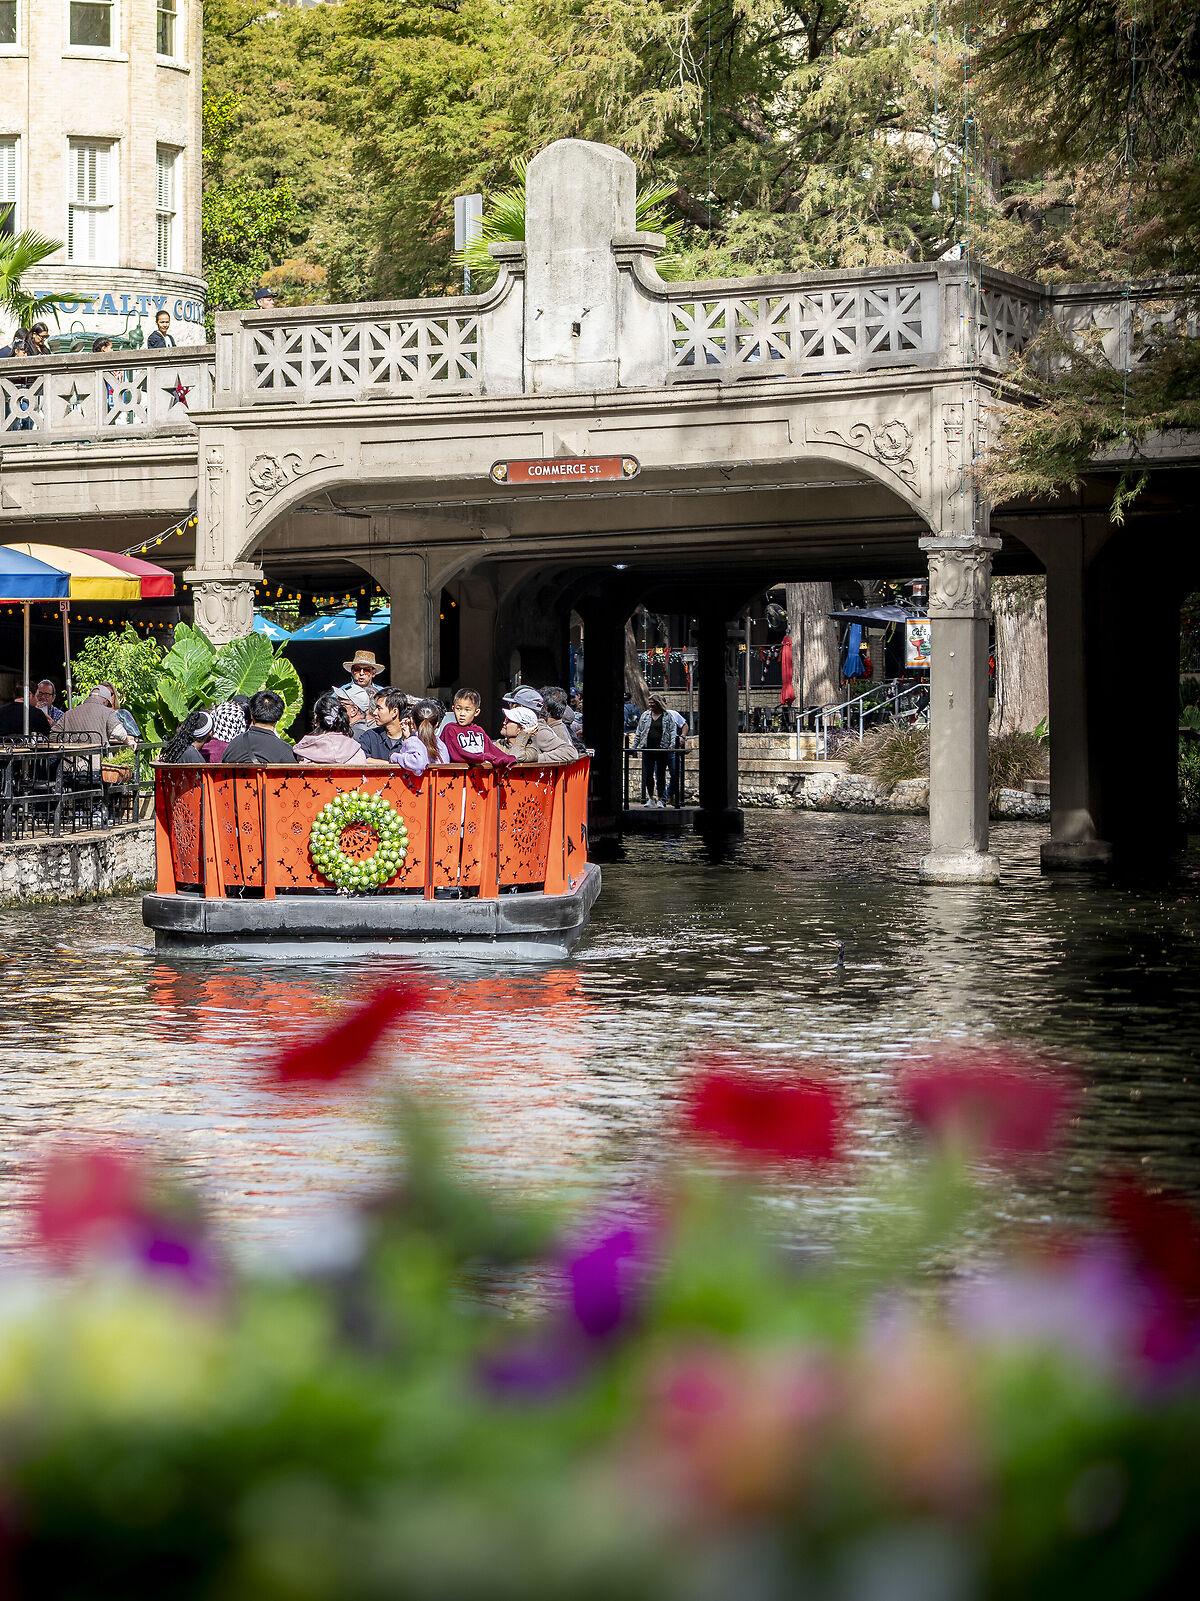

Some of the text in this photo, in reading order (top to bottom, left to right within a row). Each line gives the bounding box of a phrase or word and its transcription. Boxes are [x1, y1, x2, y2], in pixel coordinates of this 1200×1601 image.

[528, 464, 602, 476] COMMERCE ST.
[60, 601, 69, 611] 51
